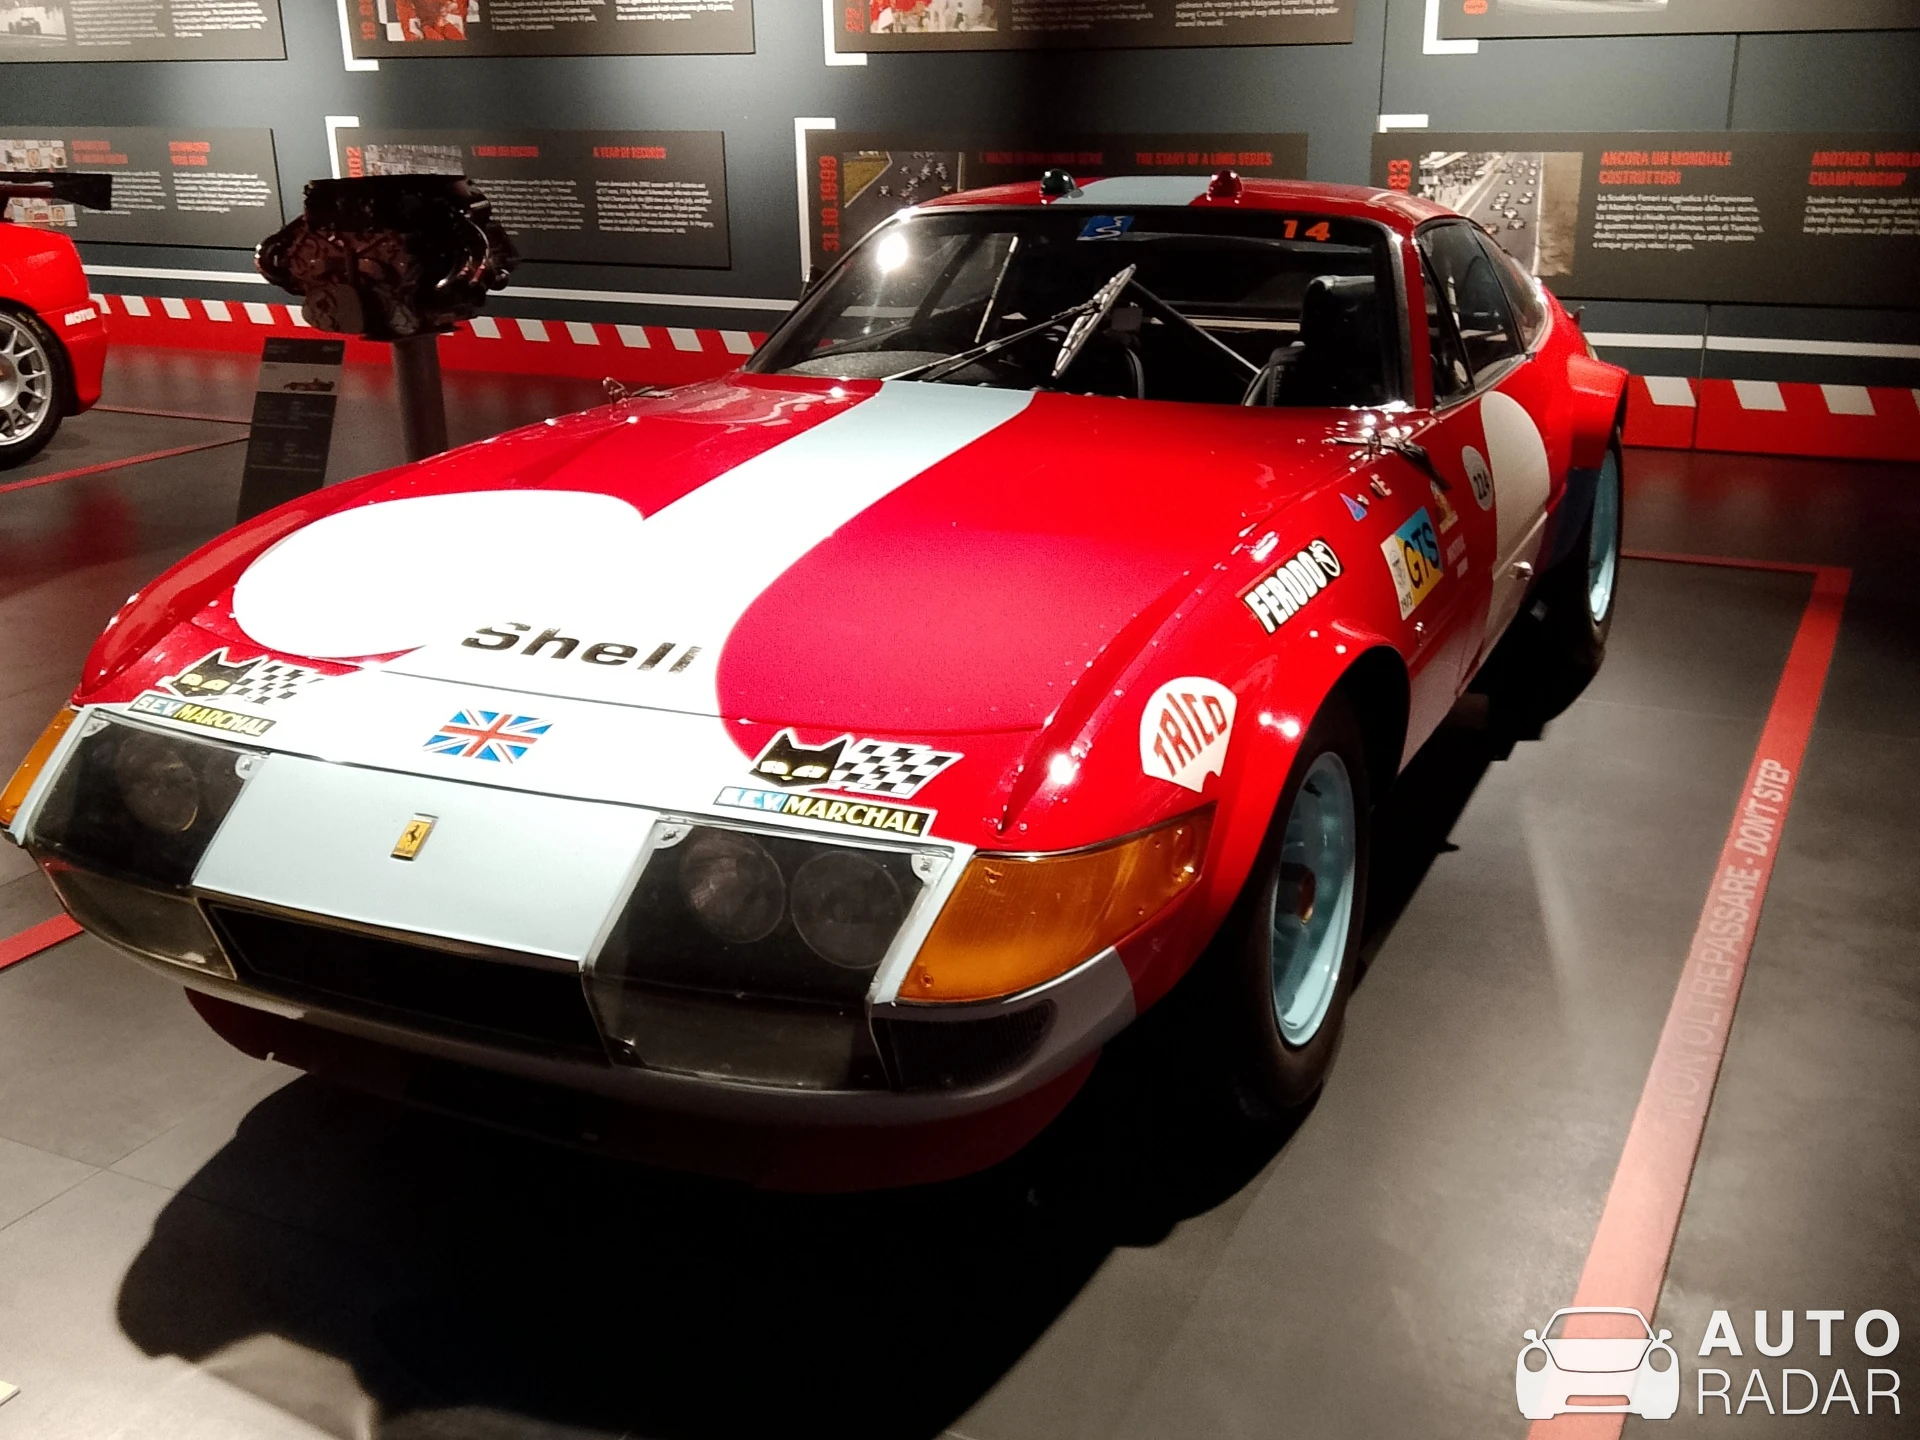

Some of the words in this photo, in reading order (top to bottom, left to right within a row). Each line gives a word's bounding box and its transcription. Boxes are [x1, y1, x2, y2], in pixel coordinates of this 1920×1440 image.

[1136, 152, 1154, 165] THE
[1156, 152, 1185, 165] START
[1211, 152, 1236, 165] LONG
[1238, 152, 1273, 165] SERIES
[1599, 170, 1682, 185] COSTRUTTORI
[1601, 151, 1649, 166] ANCORA
[1651, 151, 1669, 166] UN
[1670, 151, 1732, 166] MONDIALE
[1808, 171, 1907, 187] CHAMPIONSHIP
[1811, 151, 1871, 167] ANOTHER
[819, 155, 840, 252] 31.10.1999
[1283, 219, 1331, 242] 14
[1403, 521, 1439, 590] GTS
[1243, 550, 1329, 635] FERODO
[460, 621, 703, 674] Shell
[173, 703, 271, 735] MARCHAL
[1153, 692, 1228, 778] TRICO
[1755, 757, 1792, 804] STEP
[781, 795, 920, 835] MARCHAL
[1733, 791, 1780, 858] DON'T
[1675, 865, 1761, 1049] OLTREPASSARE
